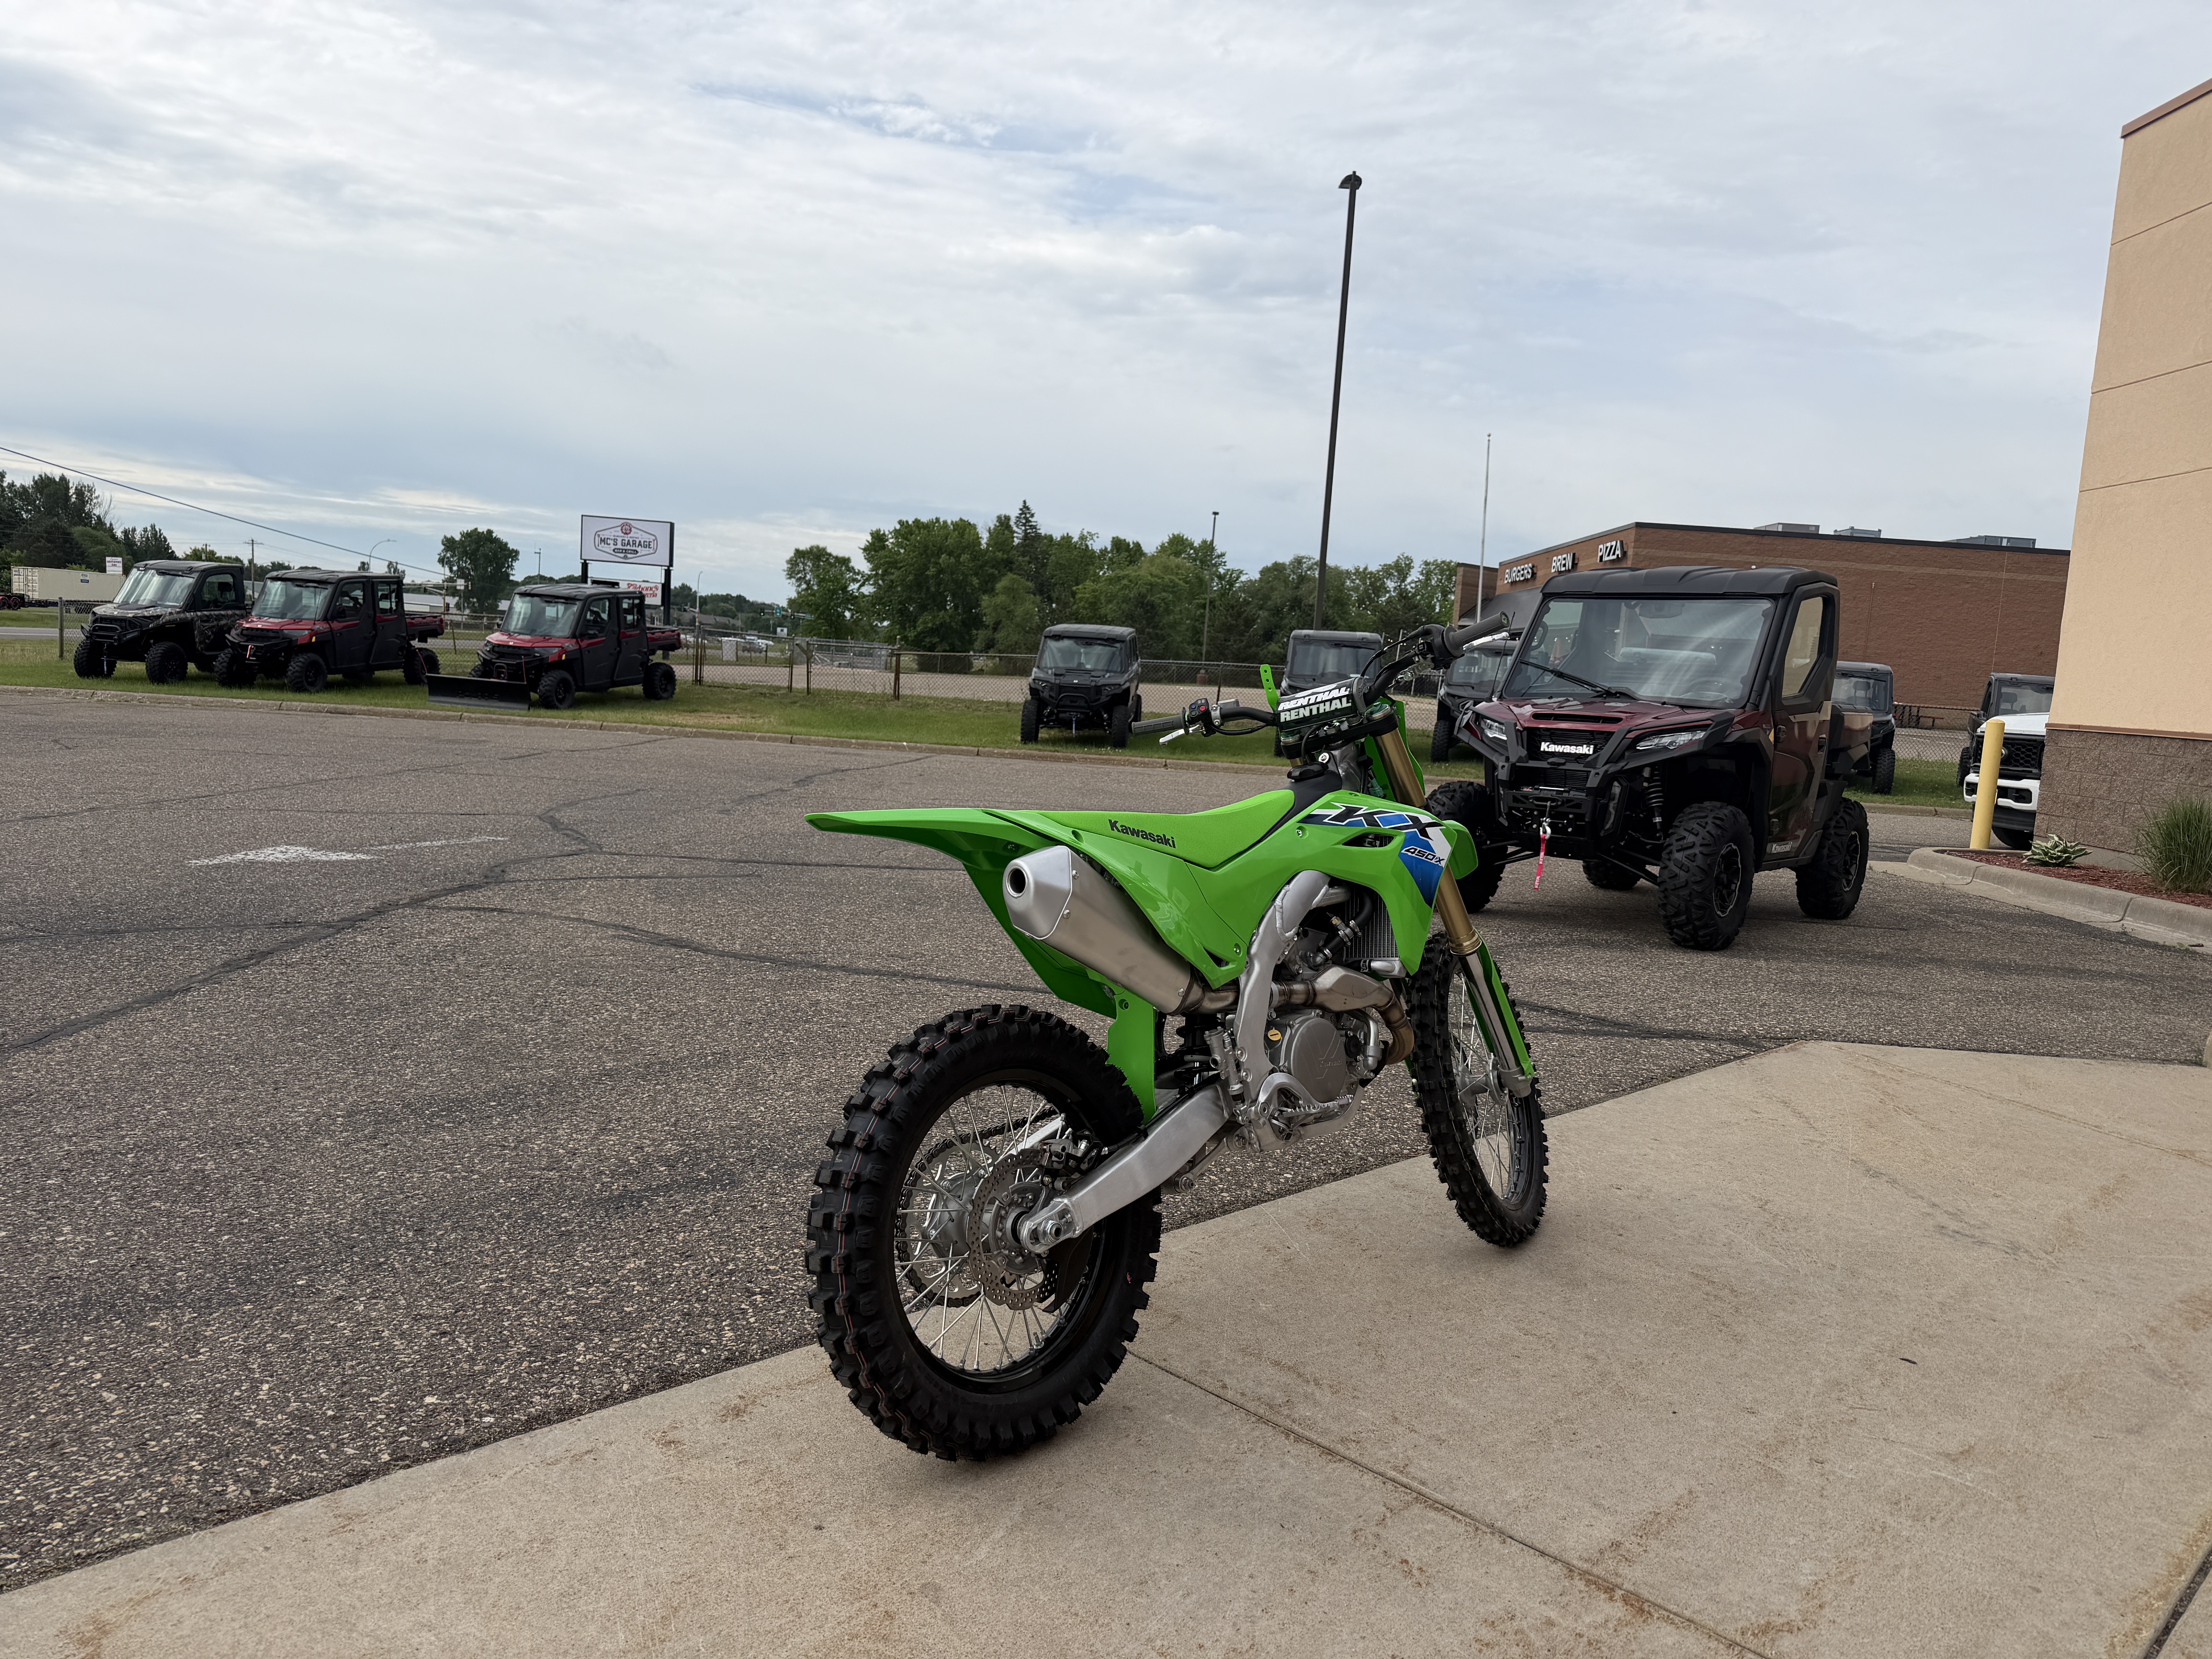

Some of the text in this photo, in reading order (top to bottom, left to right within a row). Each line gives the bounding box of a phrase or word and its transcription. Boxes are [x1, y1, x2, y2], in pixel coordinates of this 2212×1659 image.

[600, 537, 618, 546] MC'S
[621, 539, 652, 549] GARAGE
[1598, 540, 1622, 562] PIZZA
[1504, 563, 1534, 584] BURGERS
[1551, 553, 1575, 573] BREW
[1278, 687, 1349, 711] RENTHAL
[1280, 697, 1352, 722] RENTHAL
[1540, 742, 1594, 754] Kawasaki
[1108, 819, 1176, 849] Kawasaki
